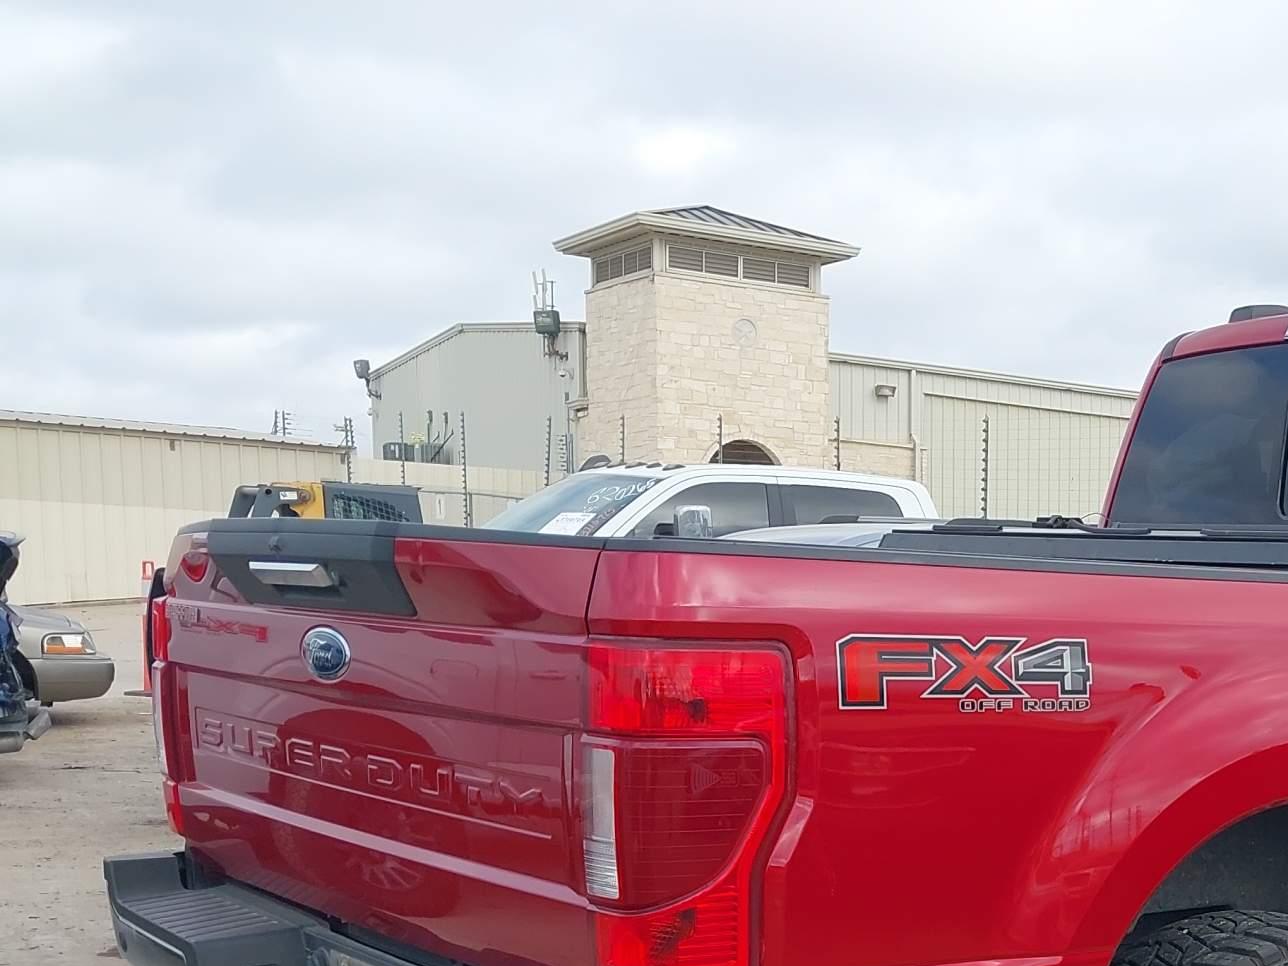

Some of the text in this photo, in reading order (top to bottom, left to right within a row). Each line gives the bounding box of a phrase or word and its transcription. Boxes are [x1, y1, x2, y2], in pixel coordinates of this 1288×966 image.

[836, 634, 1092, 710] FX4
[959, 698, 1092, 713] OFF ROAD
[201, 717, 545, 814] SUPER DUTY
